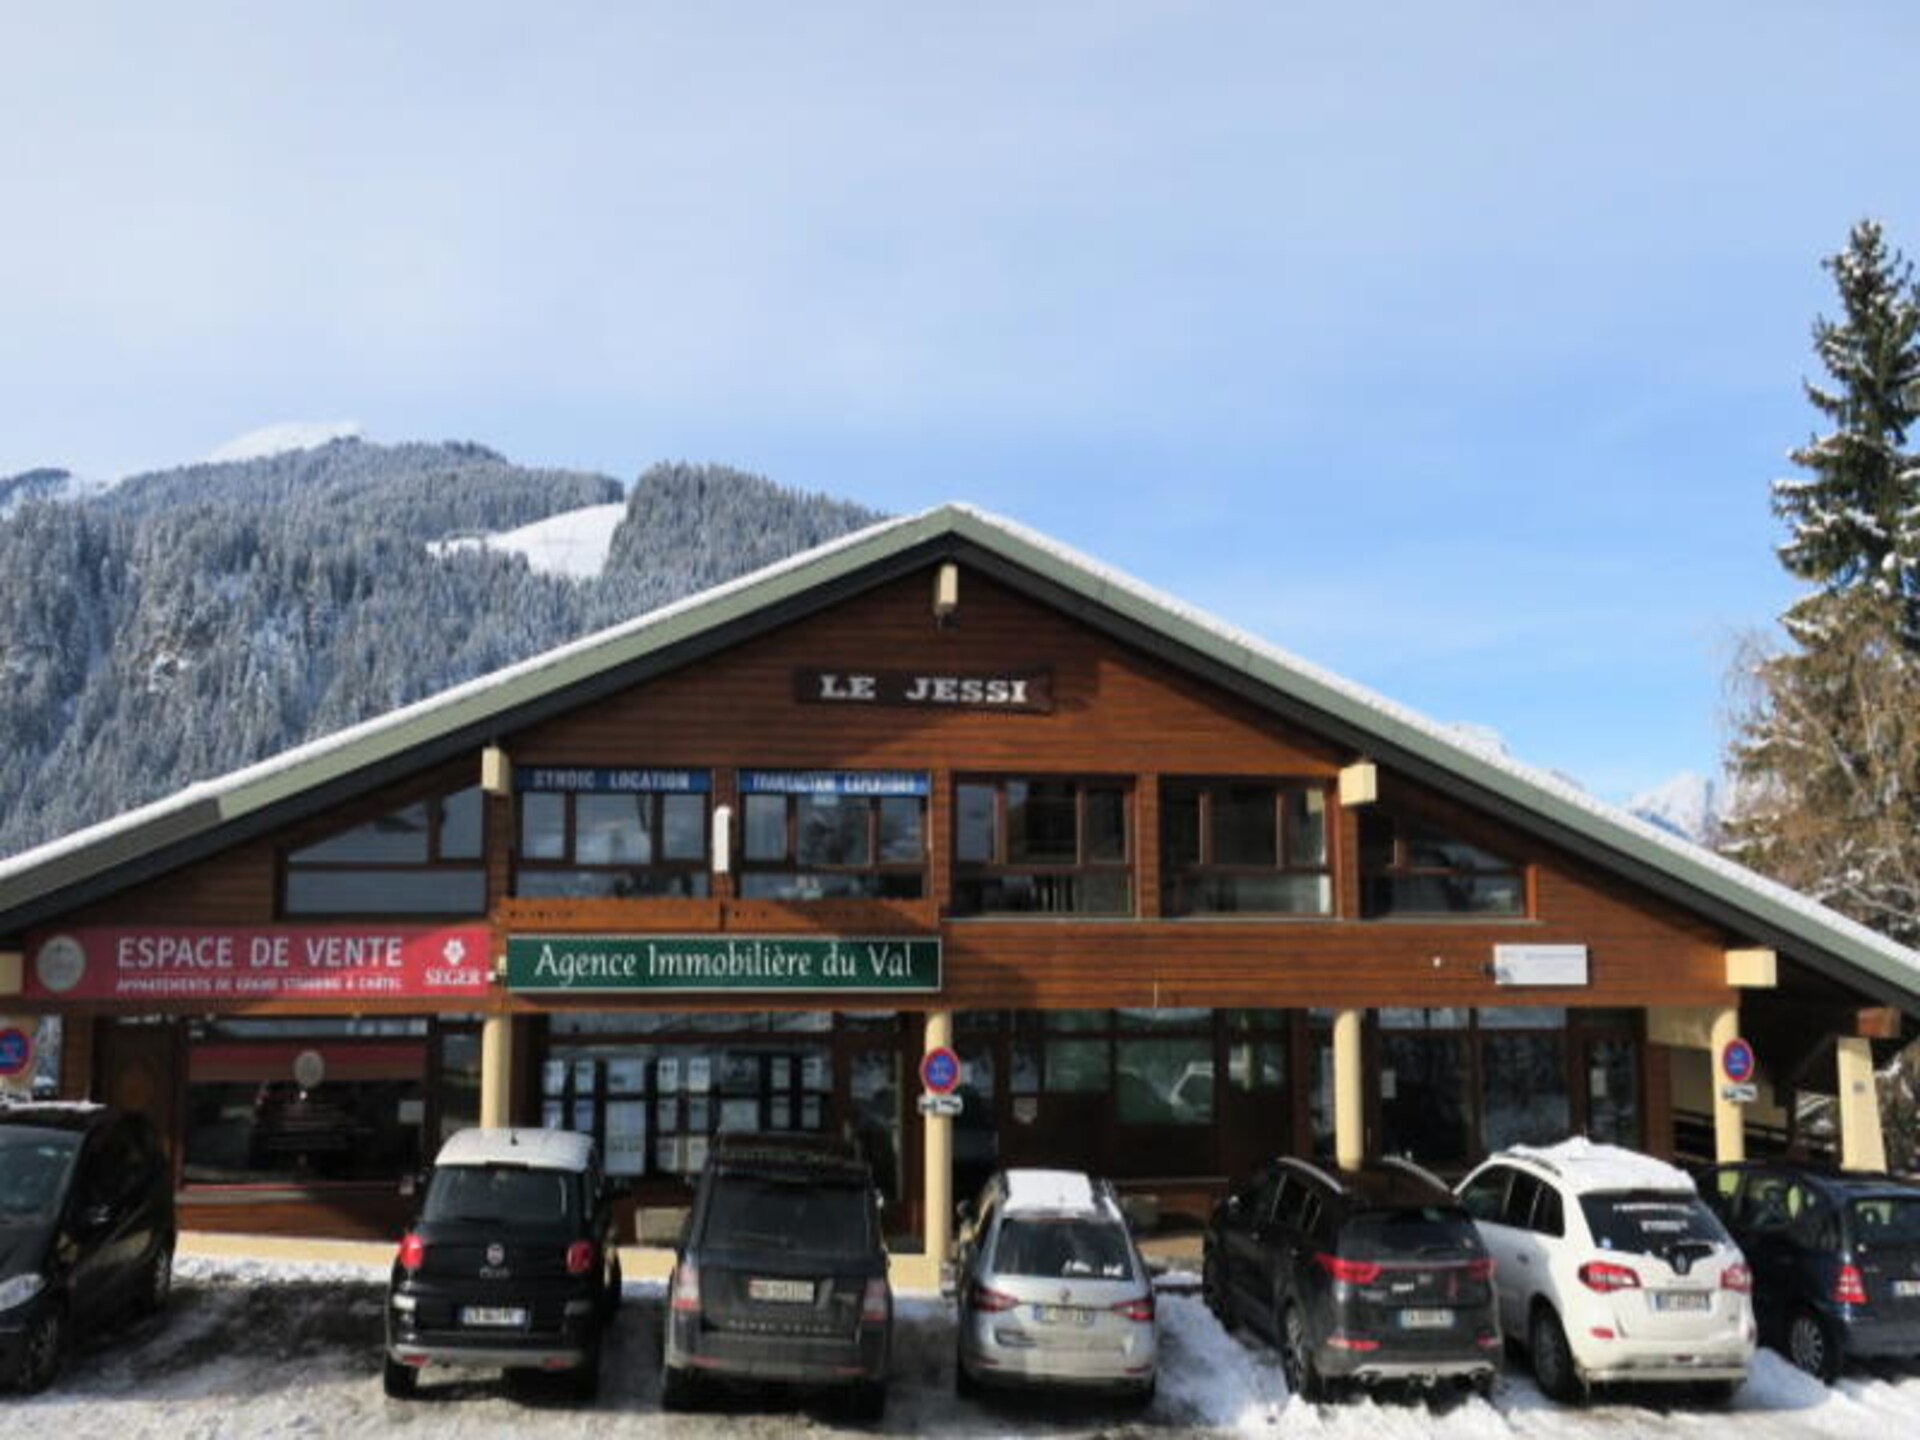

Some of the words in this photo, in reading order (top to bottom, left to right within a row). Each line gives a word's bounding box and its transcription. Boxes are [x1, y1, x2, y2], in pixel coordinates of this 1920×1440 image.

[819, 673, 877, 701] LE
[905, 677, 1030, 705] JESSI
[608, 771, 690, 791] LOCATION
[116, 935, 234, 969] ESPACE
[249, 935, 291, 969] DE
[306, 935, 404, 969] VENTE
[533, 943, 637, 987] Agence
[648, 943, 812, 977] Immobilière
[822, 943, 857, 977] du
[868, 943, 914, 977] Val
